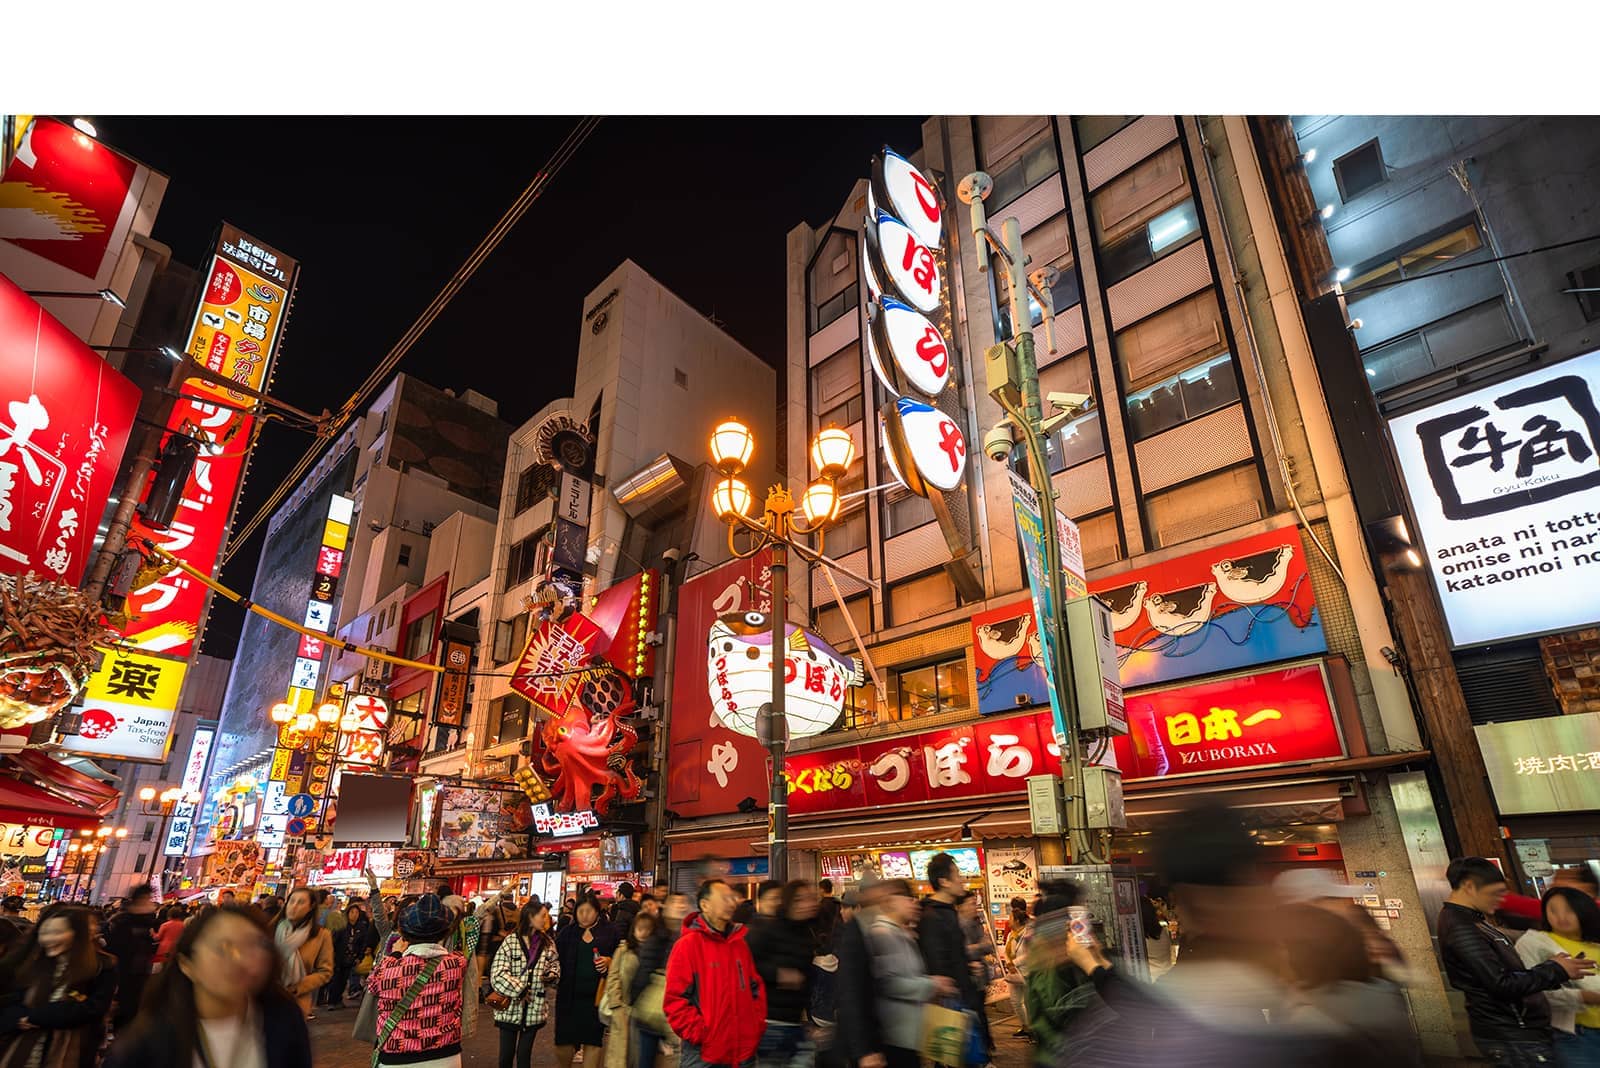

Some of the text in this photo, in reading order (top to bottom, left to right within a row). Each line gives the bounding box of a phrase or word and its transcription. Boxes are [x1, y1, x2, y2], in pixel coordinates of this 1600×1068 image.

[1450, 414, 1593, 478] 牛角
[1493, 473, 1561, 495] Gyu-Kaku
[1437, 511, 1600, 559] anata ni tott
[1442, 552, 1511, 576] omise
[1520, 542, 1543, 559] ni
[1446, 556, 1562, 593] kataomoi
[106, 660, 162, 700] 薬
[127, 724, 167, 736] Tax-free
[139, 735, 165, 745] Shop
[1164, 706, 1282, 747] 日本一
